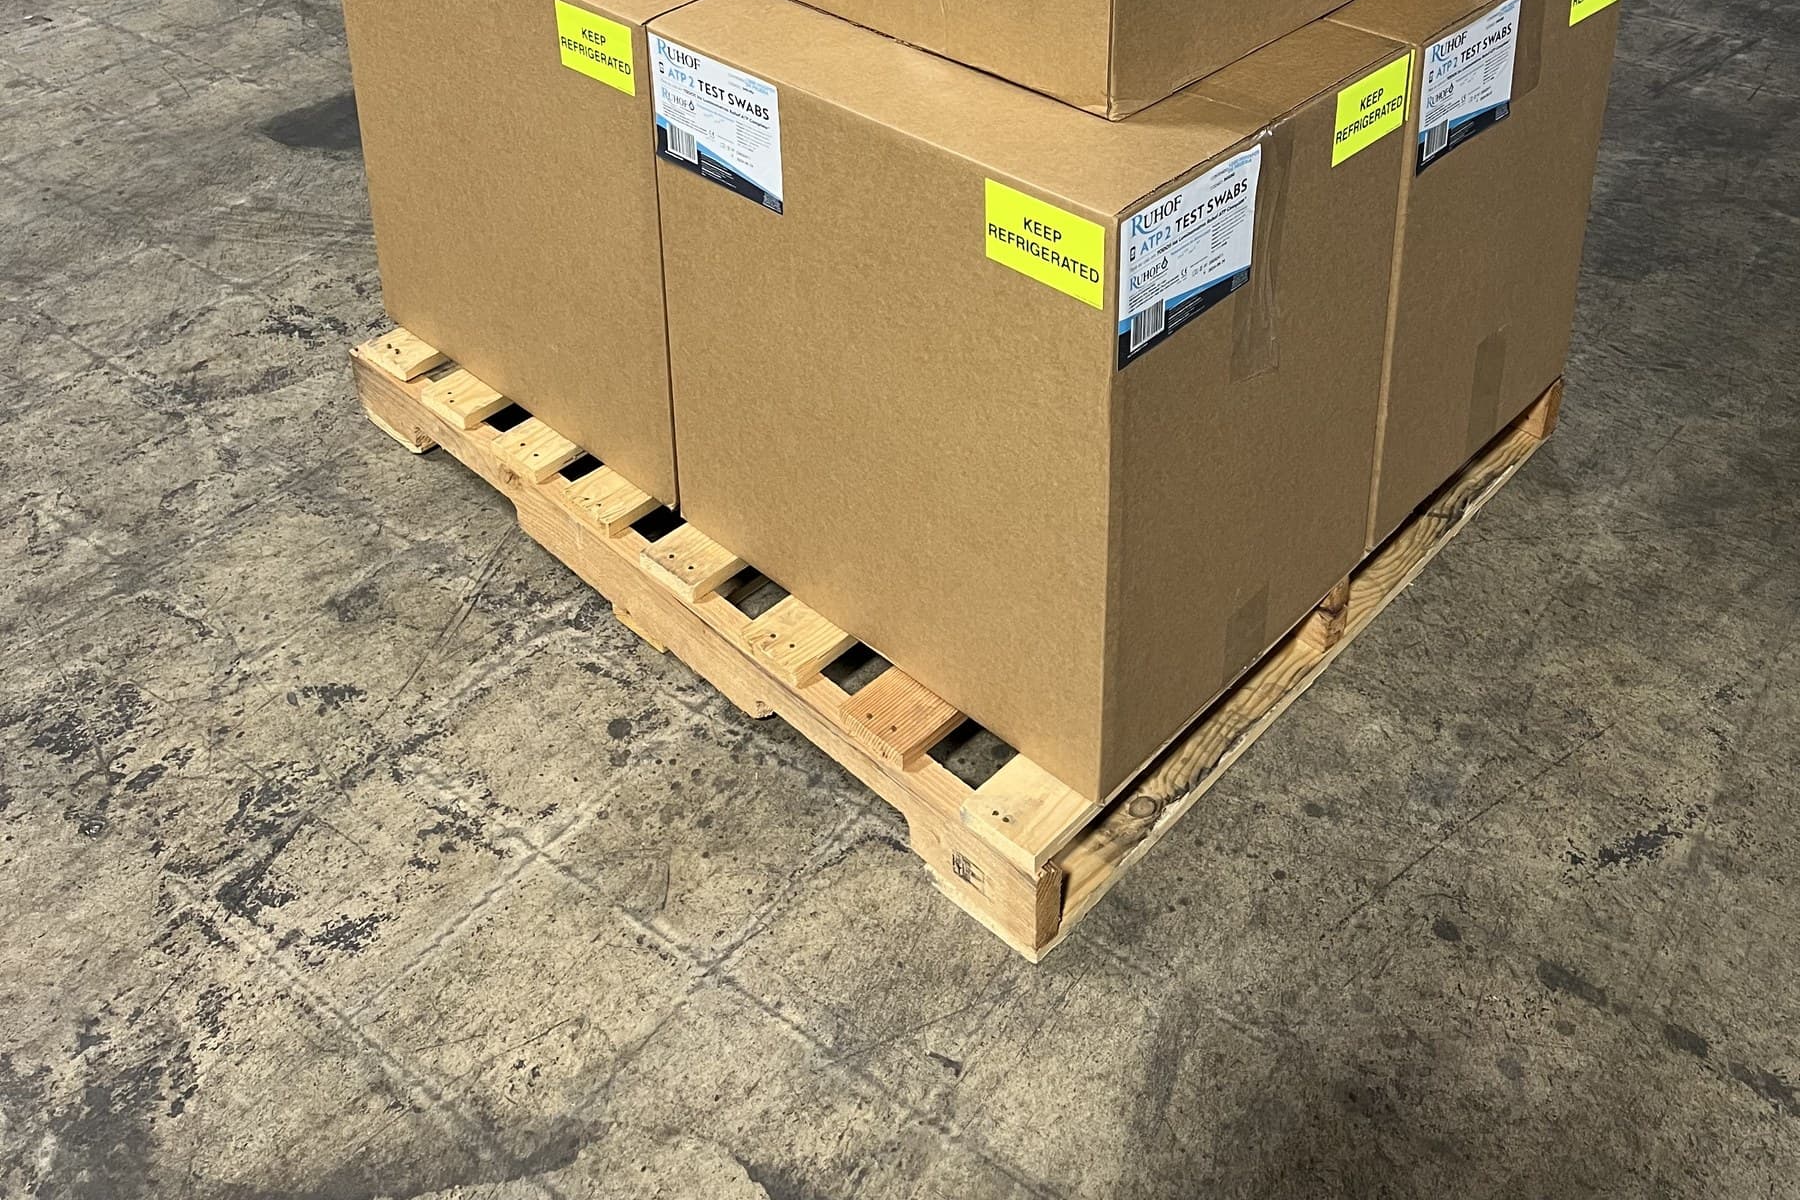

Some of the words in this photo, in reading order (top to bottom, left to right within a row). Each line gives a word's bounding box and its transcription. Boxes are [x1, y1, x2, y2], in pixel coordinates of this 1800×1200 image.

[561, 36, 631, 75] REFRIGERATED
[581, 28, 606, 46] KEEP
[657, 38, 701, 70] RUHOF
[1431, 30, 1468, 63] RUHOF
[1436, 60, 1452, 78] ATP
[1460, 41, 1481, 63] TEST
[1482, 22, 1512, 50] SWABS
[668, 67, 687, 82] ATP
[688, 75, 695, 88] 2
[697, 80, 725, 101] TEST
[728, 93, 769, 120] SWABS
[1360, 88, 1384, 112] KEEP
[1335, 95, 1403, 144] REFRIGERATED
[1023, 216, 1062, 243] KEEP
[1130, 194, 1182, 238] RUHOF
[1140, 231, 1163, 255] ATP
[1165, 226, 1171, 240] 2
[1175, 204, 1205, 232] TEST
[1206, 178, 1248, 214] SWABS
[988, 223, 1099, 283] REFRIGERATED
